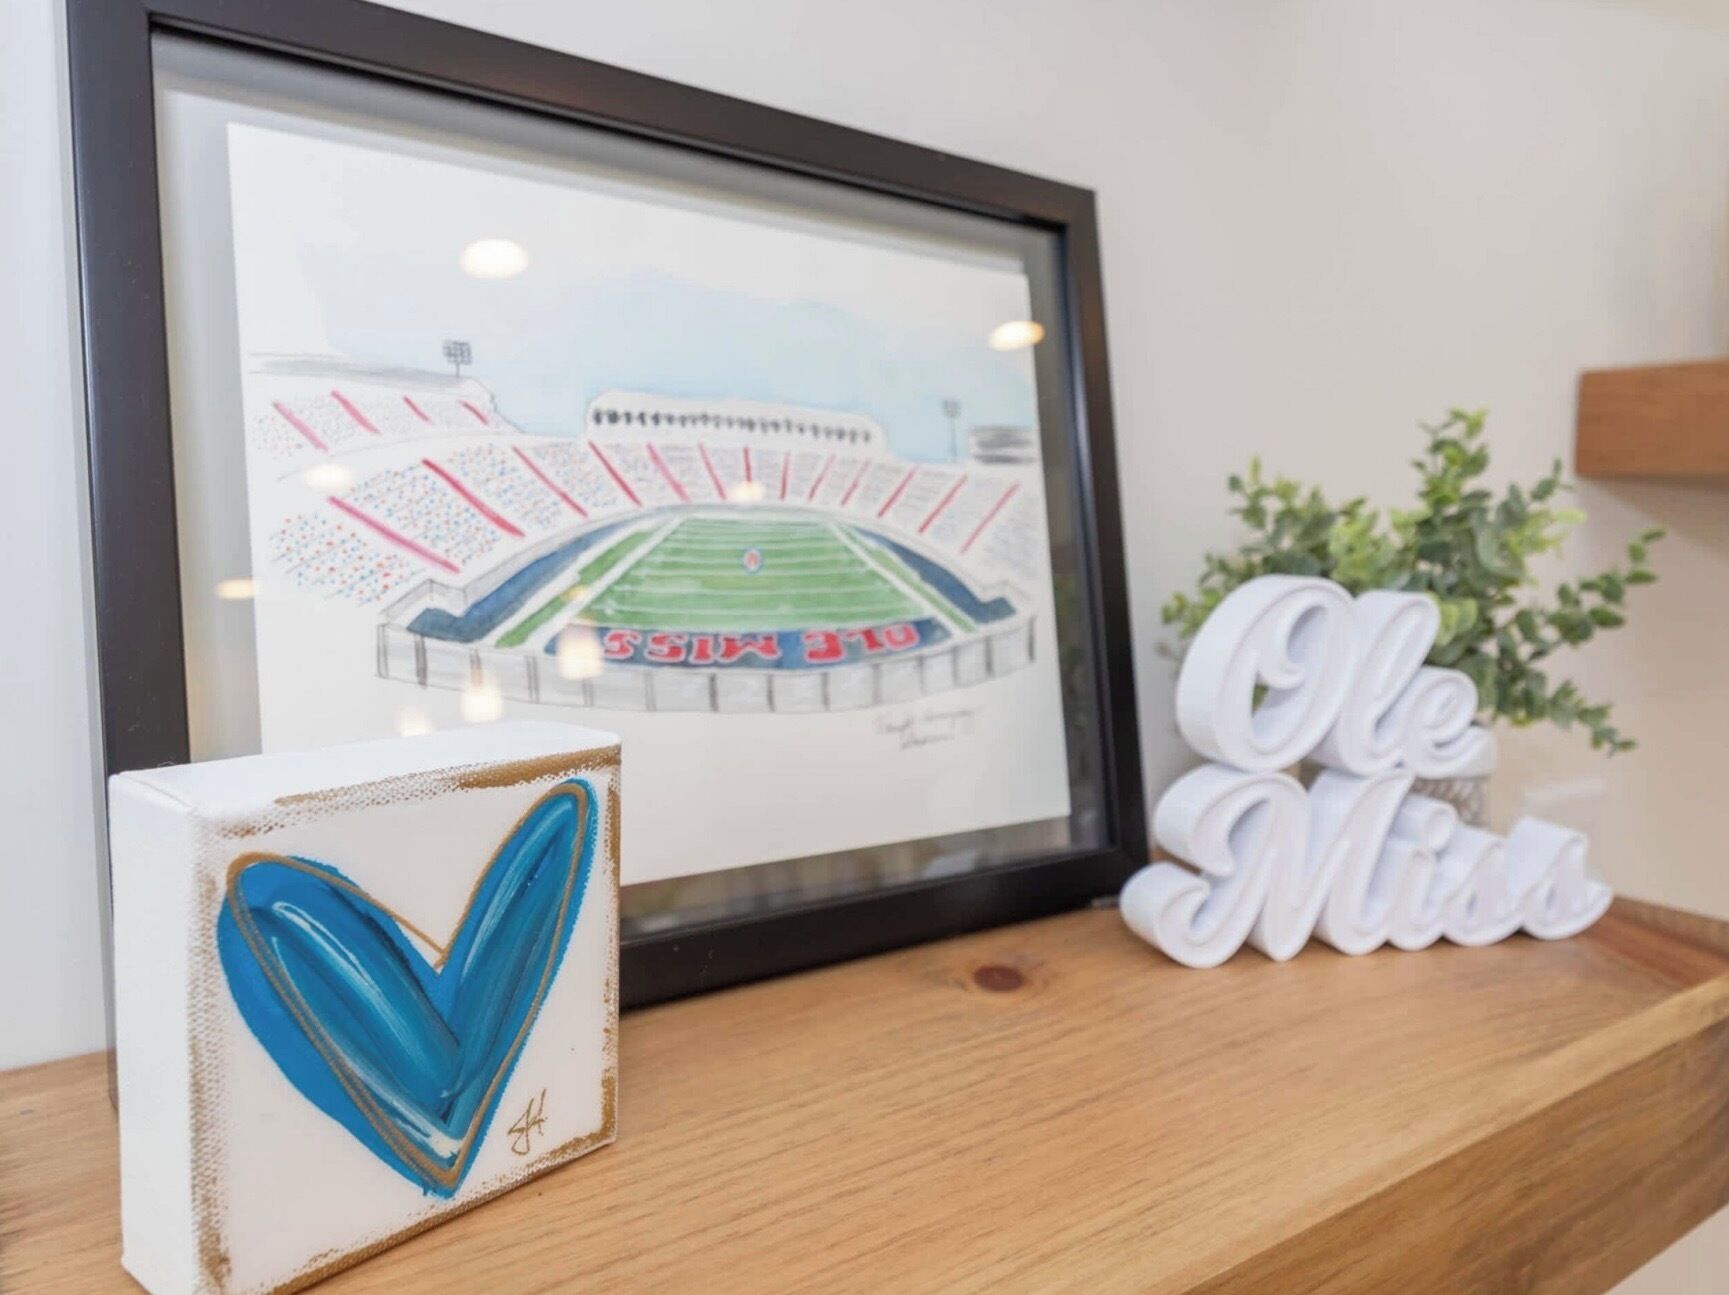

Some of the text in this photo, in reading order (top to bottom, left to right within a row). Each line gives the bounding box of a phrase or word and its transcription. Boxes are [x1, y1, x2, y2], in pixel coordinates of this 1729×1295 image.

[603, 622, 920, 664] OLE MISS
[1176, 574, 1496, 780] Ole
[1120, 762, 1614, 968] Miss
